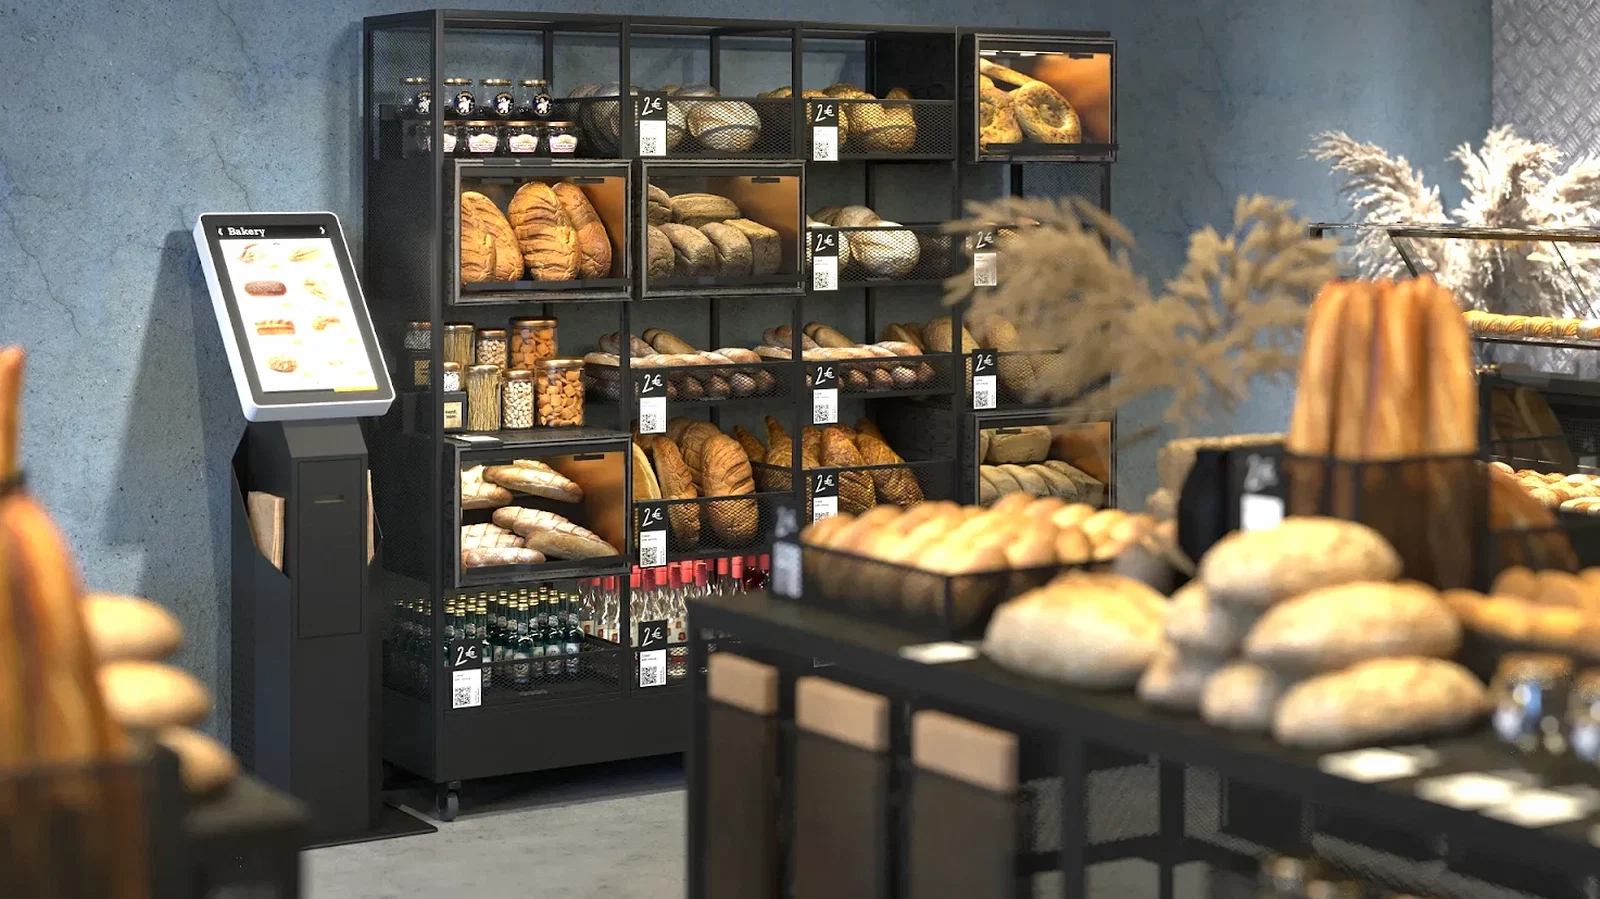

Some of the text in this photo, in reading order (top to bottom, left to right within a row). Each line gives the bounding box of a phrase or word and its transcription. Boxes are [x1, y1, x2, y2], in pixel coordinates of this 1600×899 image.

[642, 97, 663, 115] 2€
[815, 104, 835, 122] 2€
[227, 227, 265, 237] Bakery
[976, 232, 994, 249] 2€
[815, 234, 834, 252] 2€
[976, 354, 994, 372] 2€
[642, 374, 663, 393] 2€
[815, 367, 835, 385] 2€
[815, 475, 835, 492] 2€
[642, 508, 663, 526] 2€
[642, 627, 663, 646] 2€
[455, 646, 477, 666] 2€
